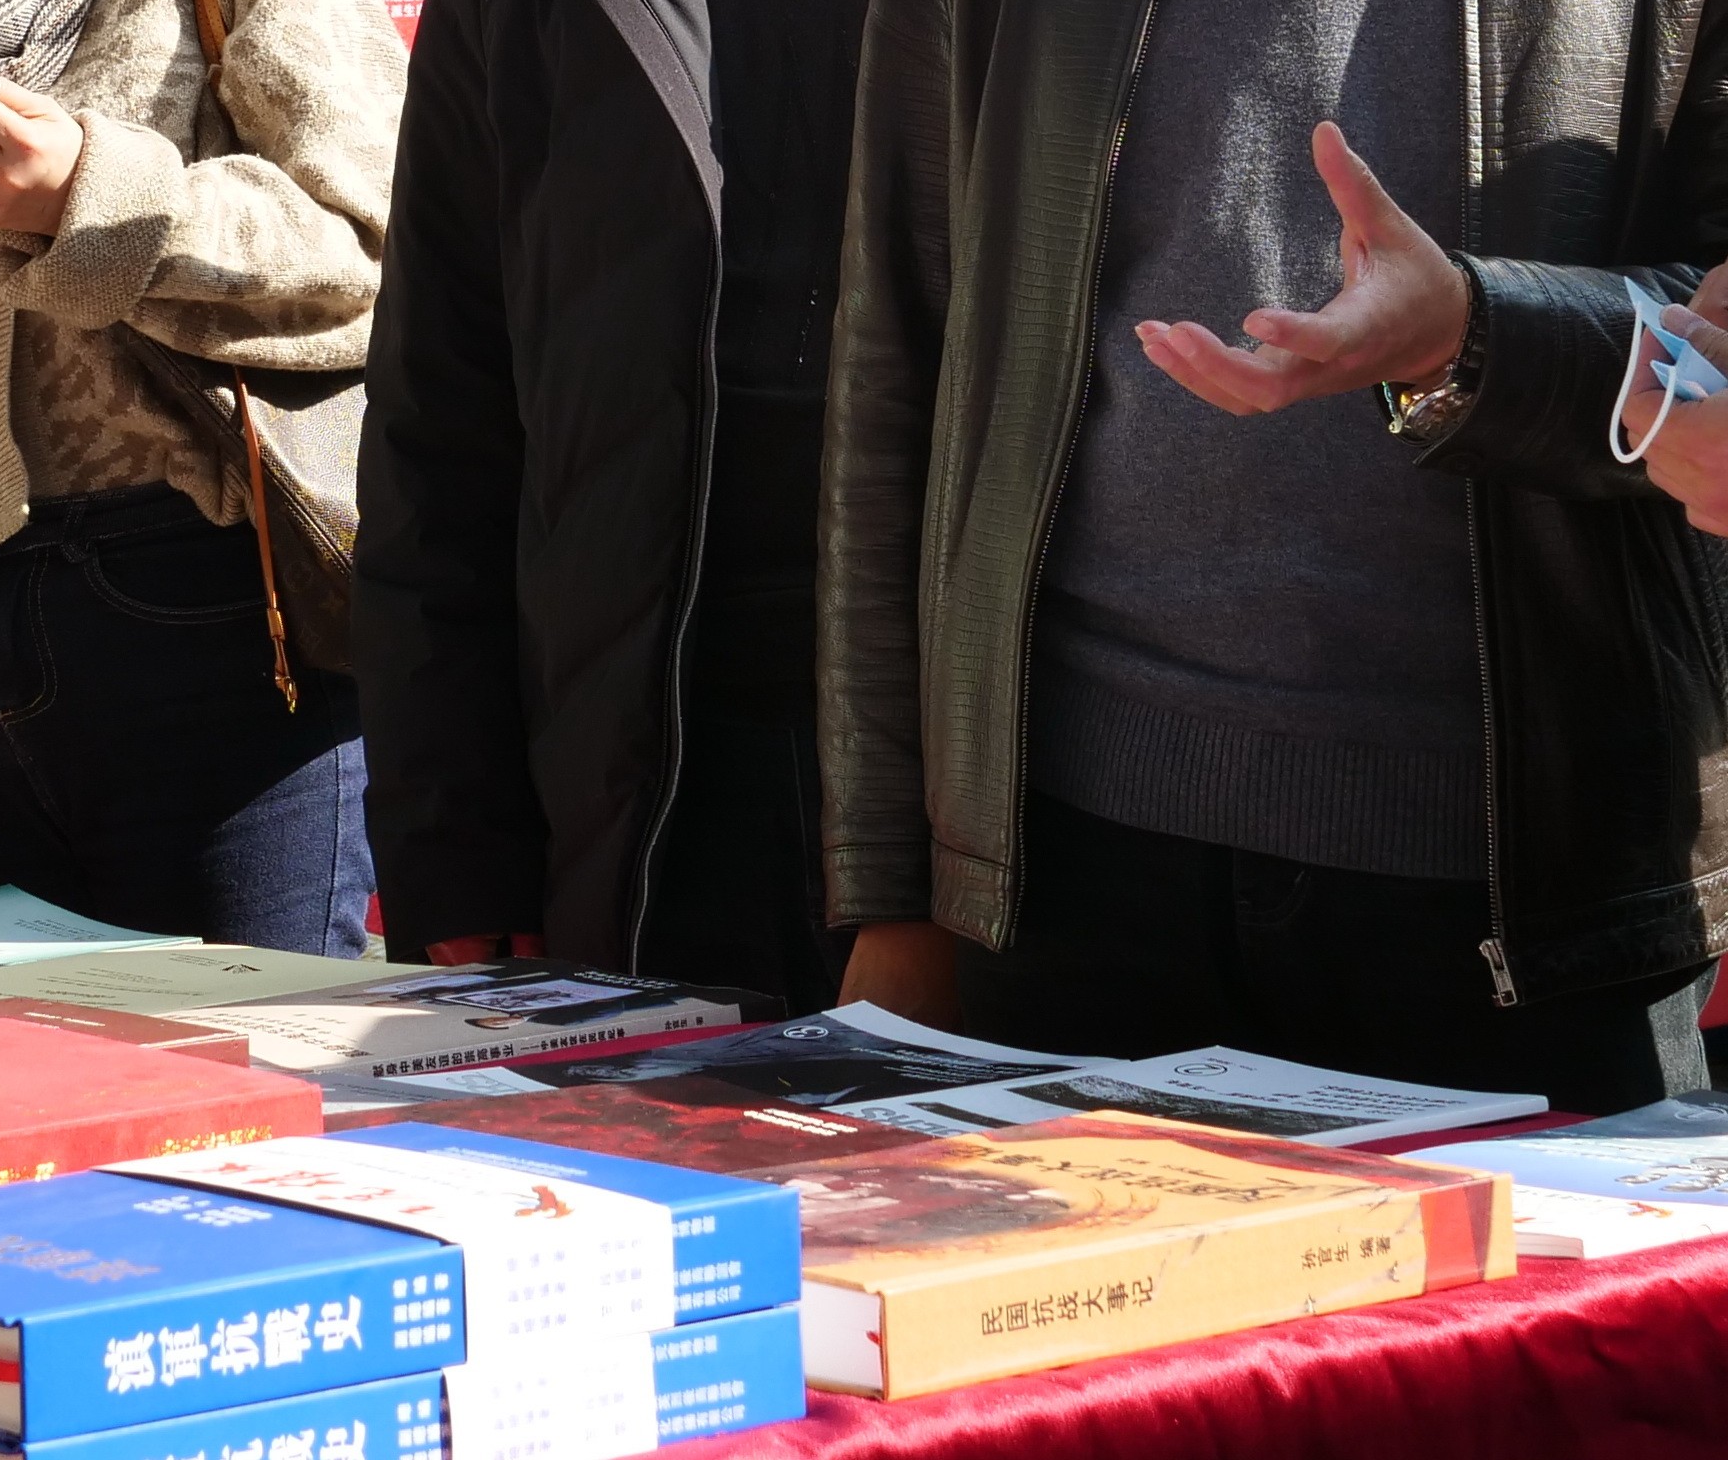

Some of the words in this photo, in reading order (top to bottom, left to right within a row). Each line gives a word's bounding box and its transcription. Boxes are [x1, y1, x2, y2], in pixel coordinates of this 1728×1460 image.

[981, 1276, 1154, 1336] 民国抗战大事记
